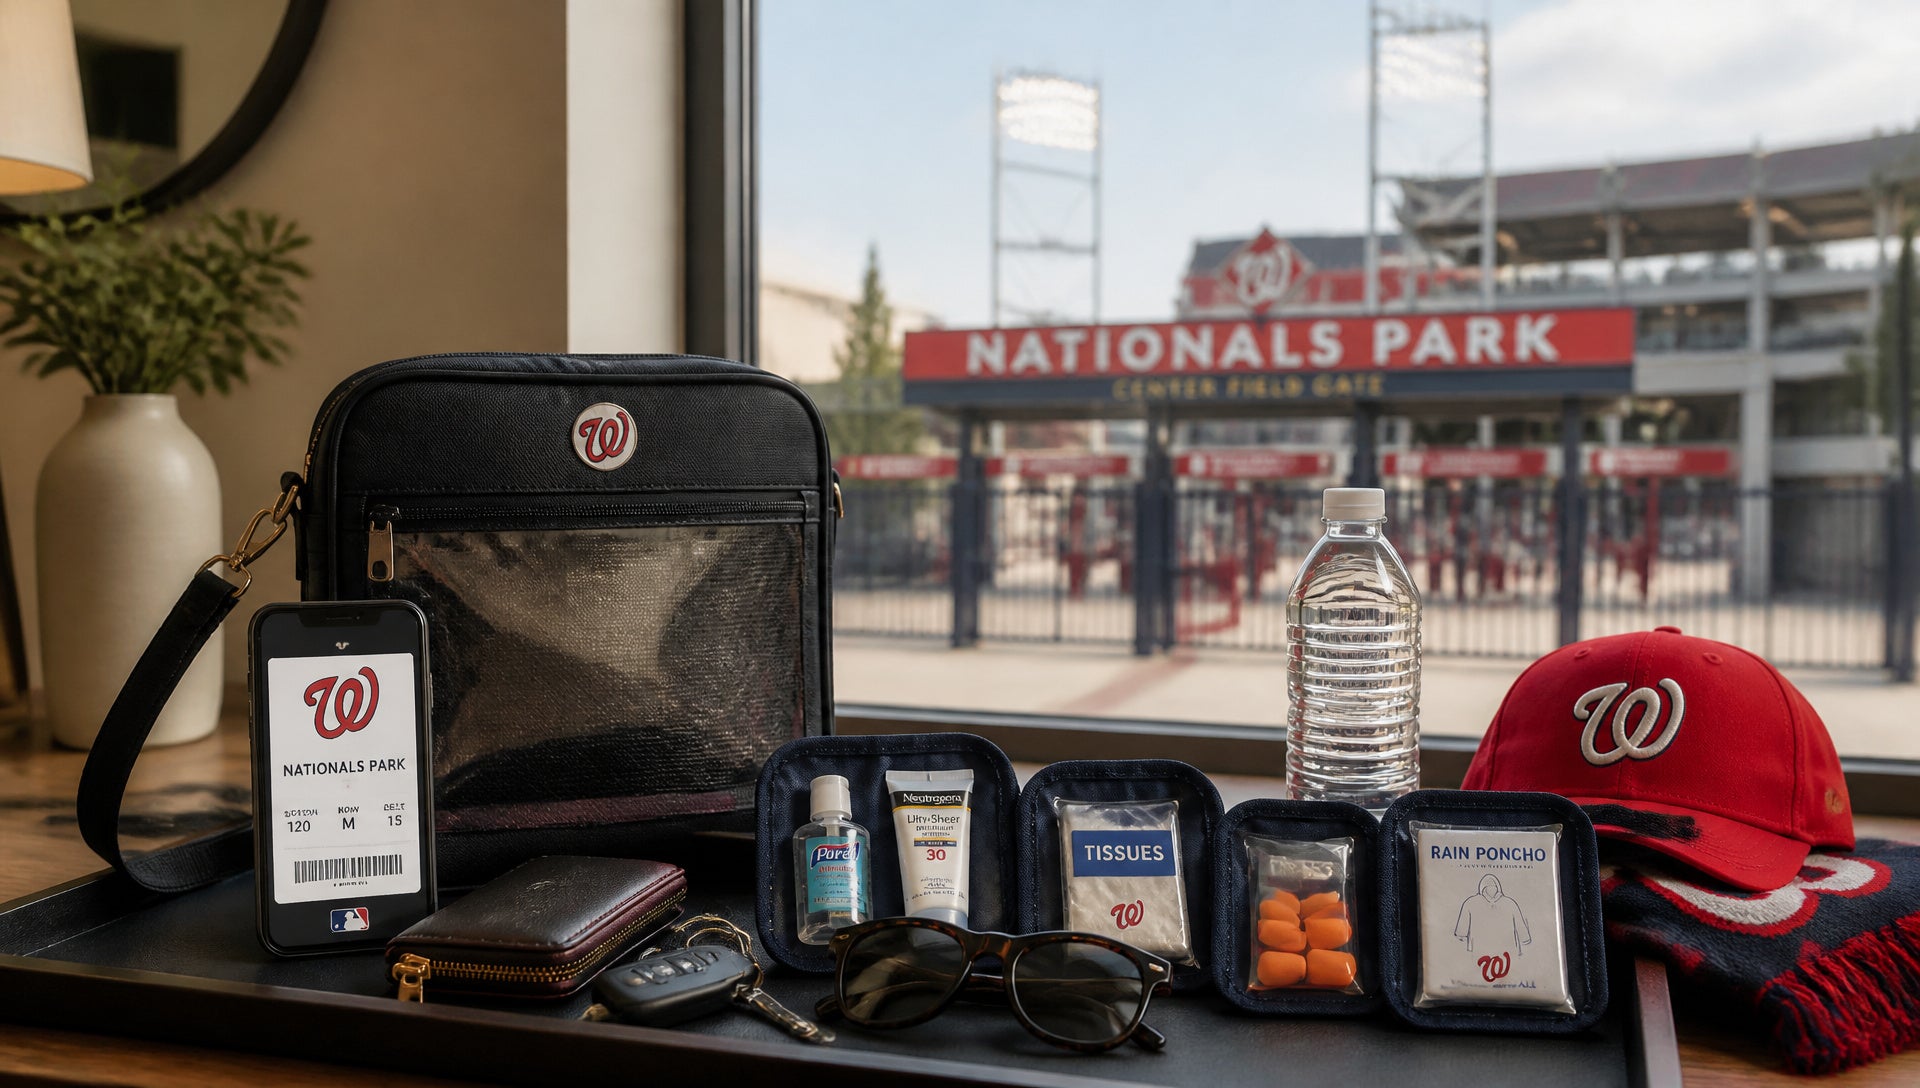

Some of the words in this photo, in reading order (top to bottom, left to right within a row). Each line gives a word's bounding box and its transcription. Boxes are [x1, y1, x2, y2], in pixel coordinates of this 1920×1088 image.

[967, 324, 1343, 374] NATIONALS
[1373, 313, 1560, 367] PARK
[1112, 376, 1216, 400] CENTER
[1226, 374, 1303, 398] FIELD
[1312, 373, 1385, 397] GATE
[283, 760, 364, 777] NATIONALS
[369, 758, 406, 772] PARK
[287, 820, 311, 833] 120
[342, 817, 355, 830] M
[926, 848, 947, 861] 30
[1084, 844, 1165, 862] TISSUES
[1431, 845, 1470, 860] RAIN
[1476, 846, 1547, 862] PONCHO
